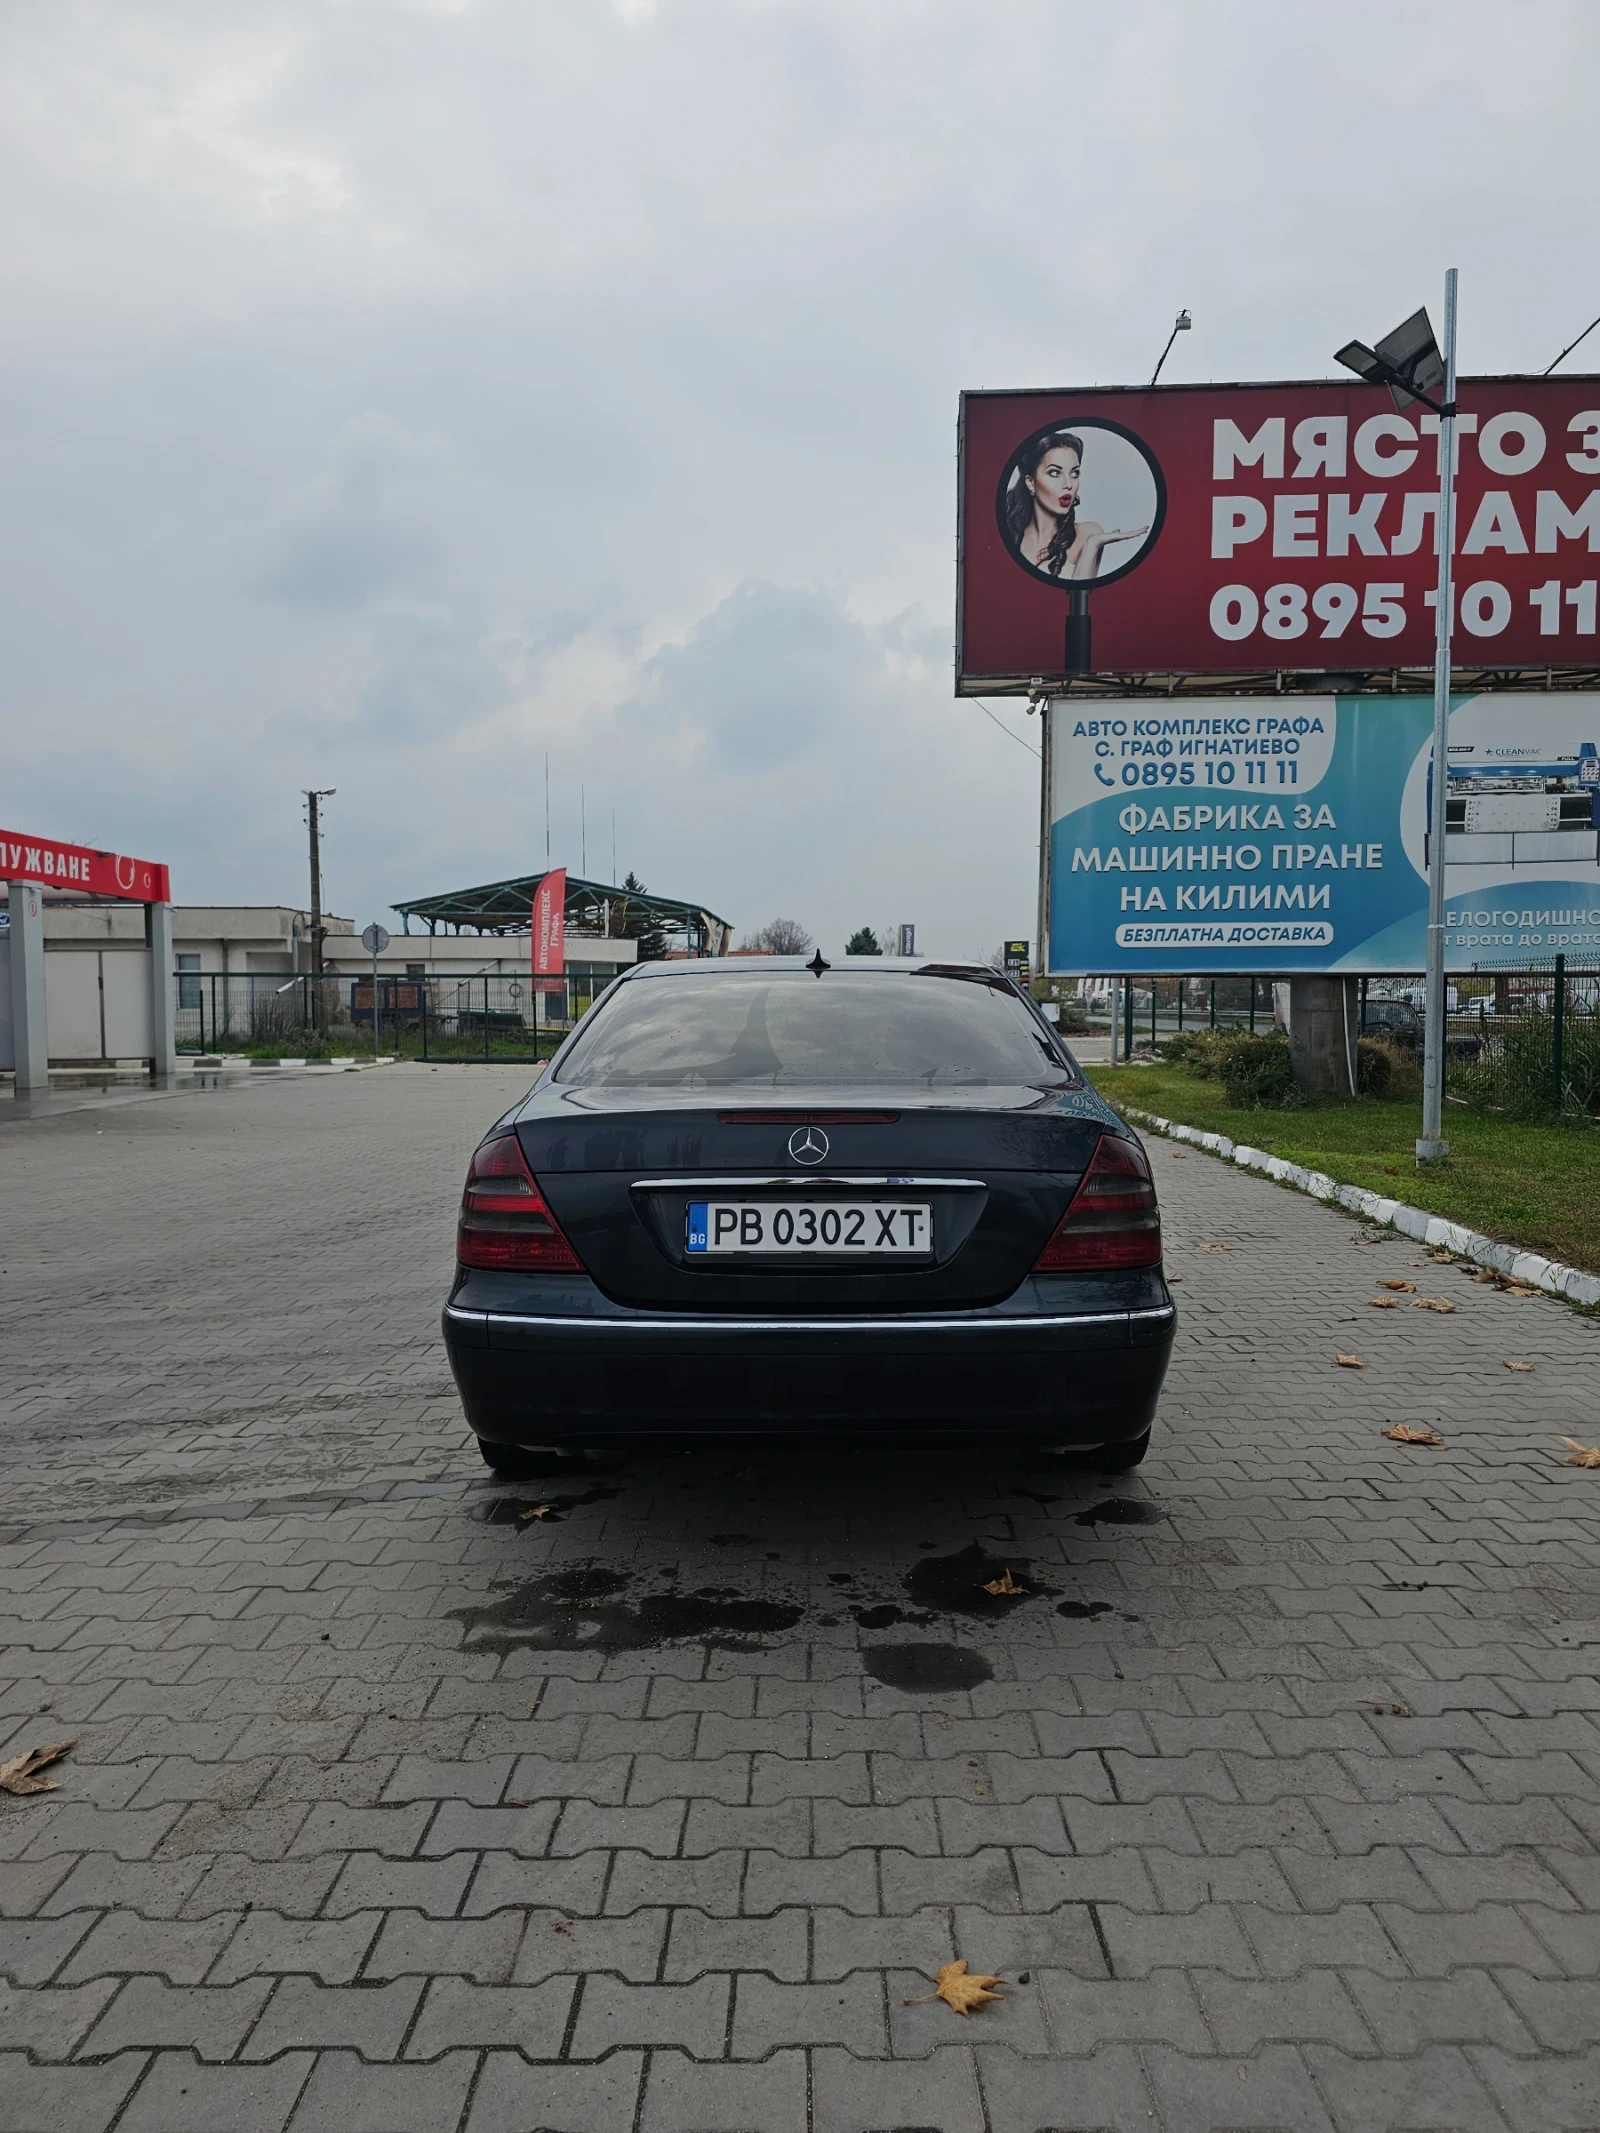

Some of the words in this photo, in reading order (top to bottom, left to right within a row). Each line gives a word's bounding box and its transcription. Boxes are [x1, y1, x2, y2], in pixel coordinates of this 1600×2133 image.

[1213, 411, 1546, 480] МЯСТО
[1211, 489, 1600, 558] РЕКЛАМ
[1209, 582, 1407, 641] 0895
[1529, 579, 1597, 636] 11
[1073, 720, 1127, 737] АВТО
[1134, 718, 1251, 736] КОМПЛЕКС
[1256, 716, 1324, 736] ГРАФА
[1095, 740, 1115, 757] С.
[1121, 738, 1173, 758] ГРАФ
[1180, 738, 1300, 756] ИГНАТИЕВО
[1495, 748, 1542, 756] CLEANVAC
[1121, 761, 1195, 786] 0895
[1204, 761, 1235, 785] 10
[1245, 761, 1266, 784] 11
[1276, 760, 1298, 784] 11
[1119, 803, 1285, 835] ФАБРИКА
[1293, 804, 1337, 830] ЗА
[1071, 844, 1262, 873] МАШИННО
[1272, 843, 1383, 870] ПРАНЕ
[1120, 886, 1167, 911] НА
[1176, 884, 1331, 910] КИЛИМИ
[540, 889, 550, 970] АВТОКОМПЛЕКС
[550, 912, 559, 946] ГРАФА
[1446, 910, 1600, 928] ЕЛОГОДИШНО
[1123, 927, 1225, 943] БЕЗПЛАТНА
[1227, 927, 1326, 943] ДОСТАВКА
[1456, 933, 1514, 948] врата
[1518, 933, 1542, 946] до
[690, 1233, 706, 1244] BG
[714, 1208, 763, 1245] PB
[773, 1208, 865, 1245] 0302
[874, 1209, 923, 1247] XT
